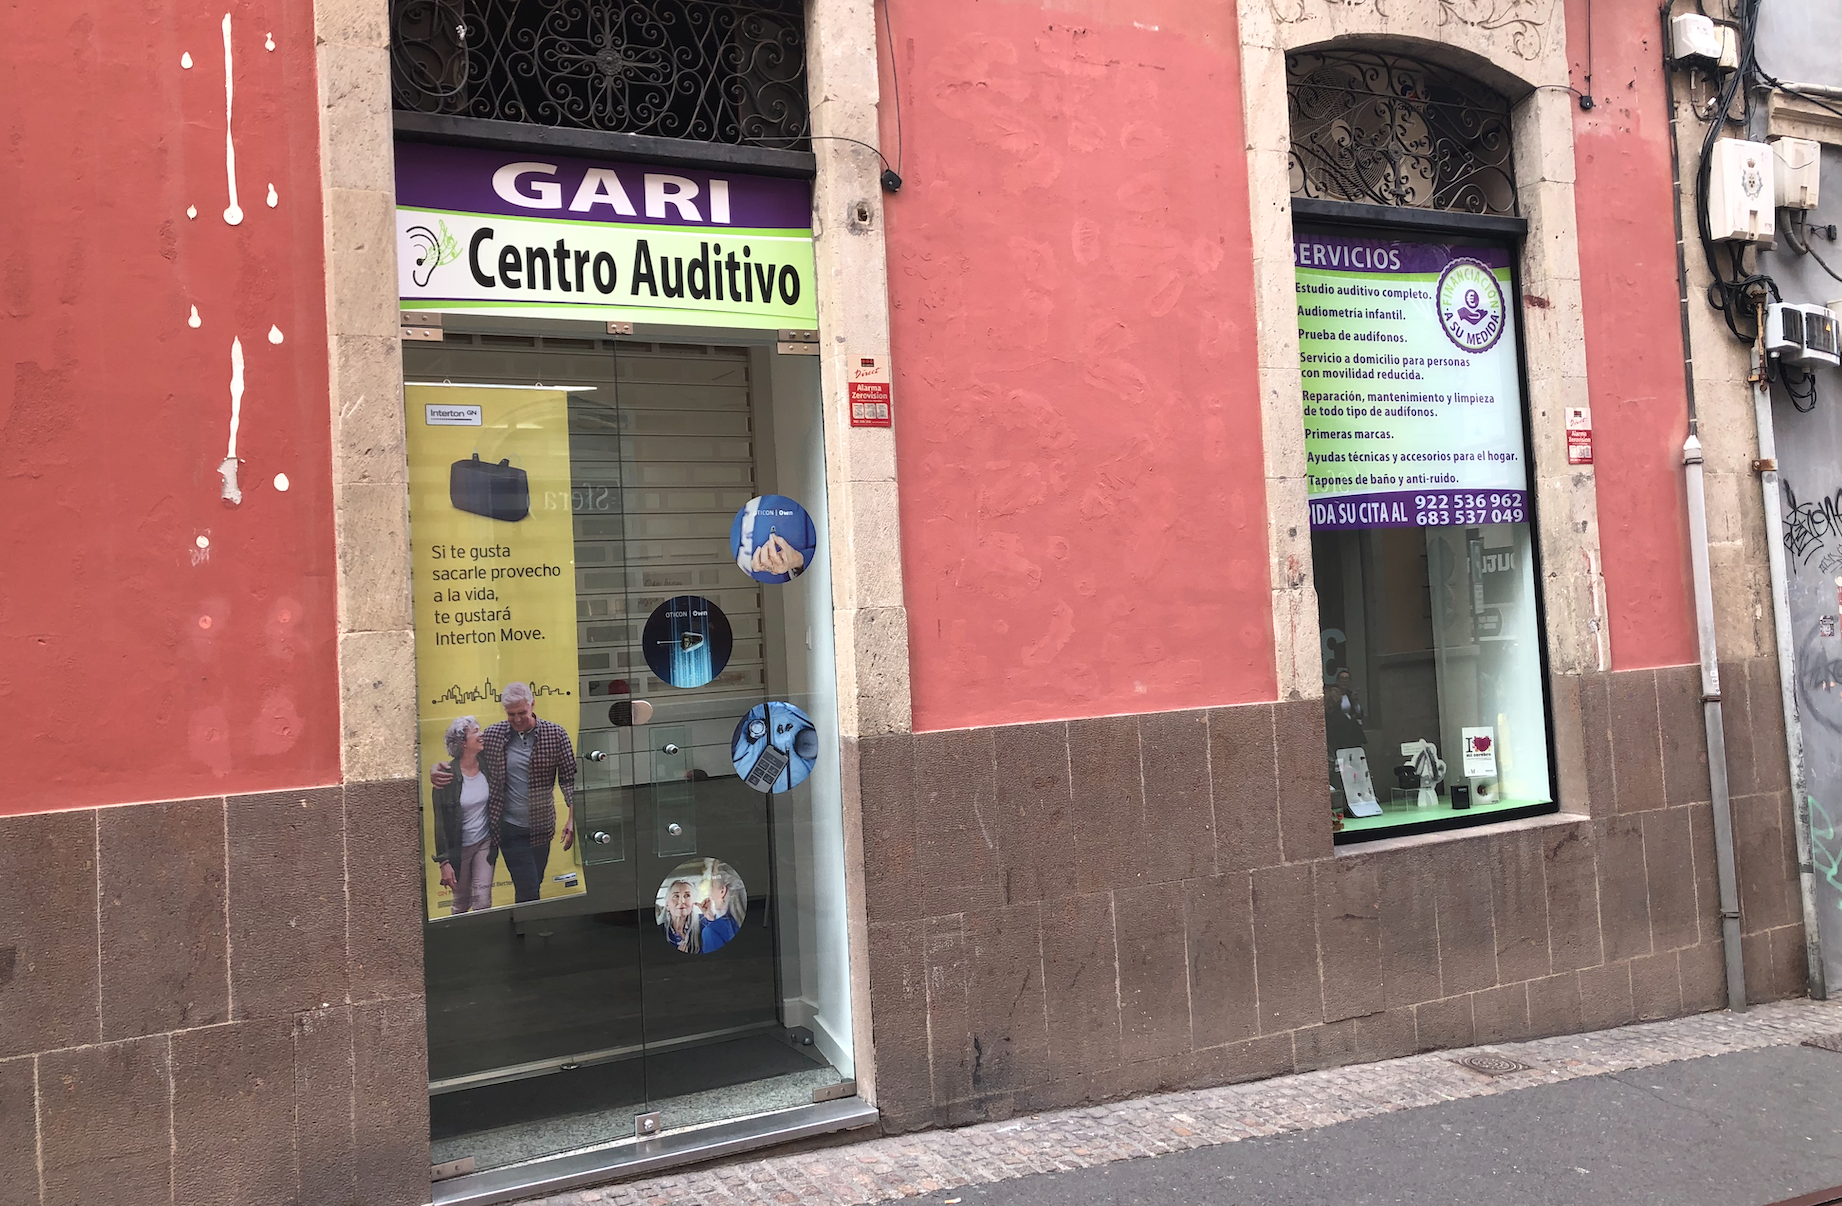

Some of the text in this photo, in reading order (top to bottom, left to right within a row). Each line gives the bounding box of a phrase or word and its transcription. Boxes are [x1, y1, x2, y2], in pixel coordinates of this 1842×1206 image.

[492, 161, 731, 224] GARI
[468, 227, 801, 306] Centro Auditivo
[1295, 282, 1432, 301] Estudio auditivo completo.
[1442, 267, 1500, 309] FINANCIACIÓN
[1297, 305, 1406, 321] Audiometría infantil.
[1298, 328, 1408, 343] Prueba de audífonos.
[1443, 312, 1500, 346] A SU MEDIDA
[1300, 352, 1471, 368] Servicio a domicilio para personas
[1301, 368, 1424, 380] con movilidad reducida.
[851, 392, 888, 400] Zerovision
[856, 384, 882, 392] Alarma
[1302, 390, 1495, 406] Reparación, mantenimiento y limpieza
[430, 409, 465, 417] Interton
[1304, 405, 1438, 419] de todo tipo de audífonos.
[1305, 428, 1394, 439] Primeras marcas.
[1307, 450, 1518, 465] Ayudas técnicas y accesorios para el hogar.
[1308, 472, 1459, 488] Tapones de baño y anti-ruido.
[1414, 493, 1523, 510] 922 536 962
[1309, 501, 1409, 525] IDA SU CITA AL
[1416, 508, 1524, 526] 683 537 049
[431, 545, 511, 562] Si te gusta
[432, 563, 562, 582] sacarle provecho
[433, 587, 500, 603] a la vida,
[434, 607, 512, 626] te gustará
[664, 611, 689, 619] OTICON
[435, 627, 546, 646] Interton Move.
[1465, 737, 1473, 753] I
